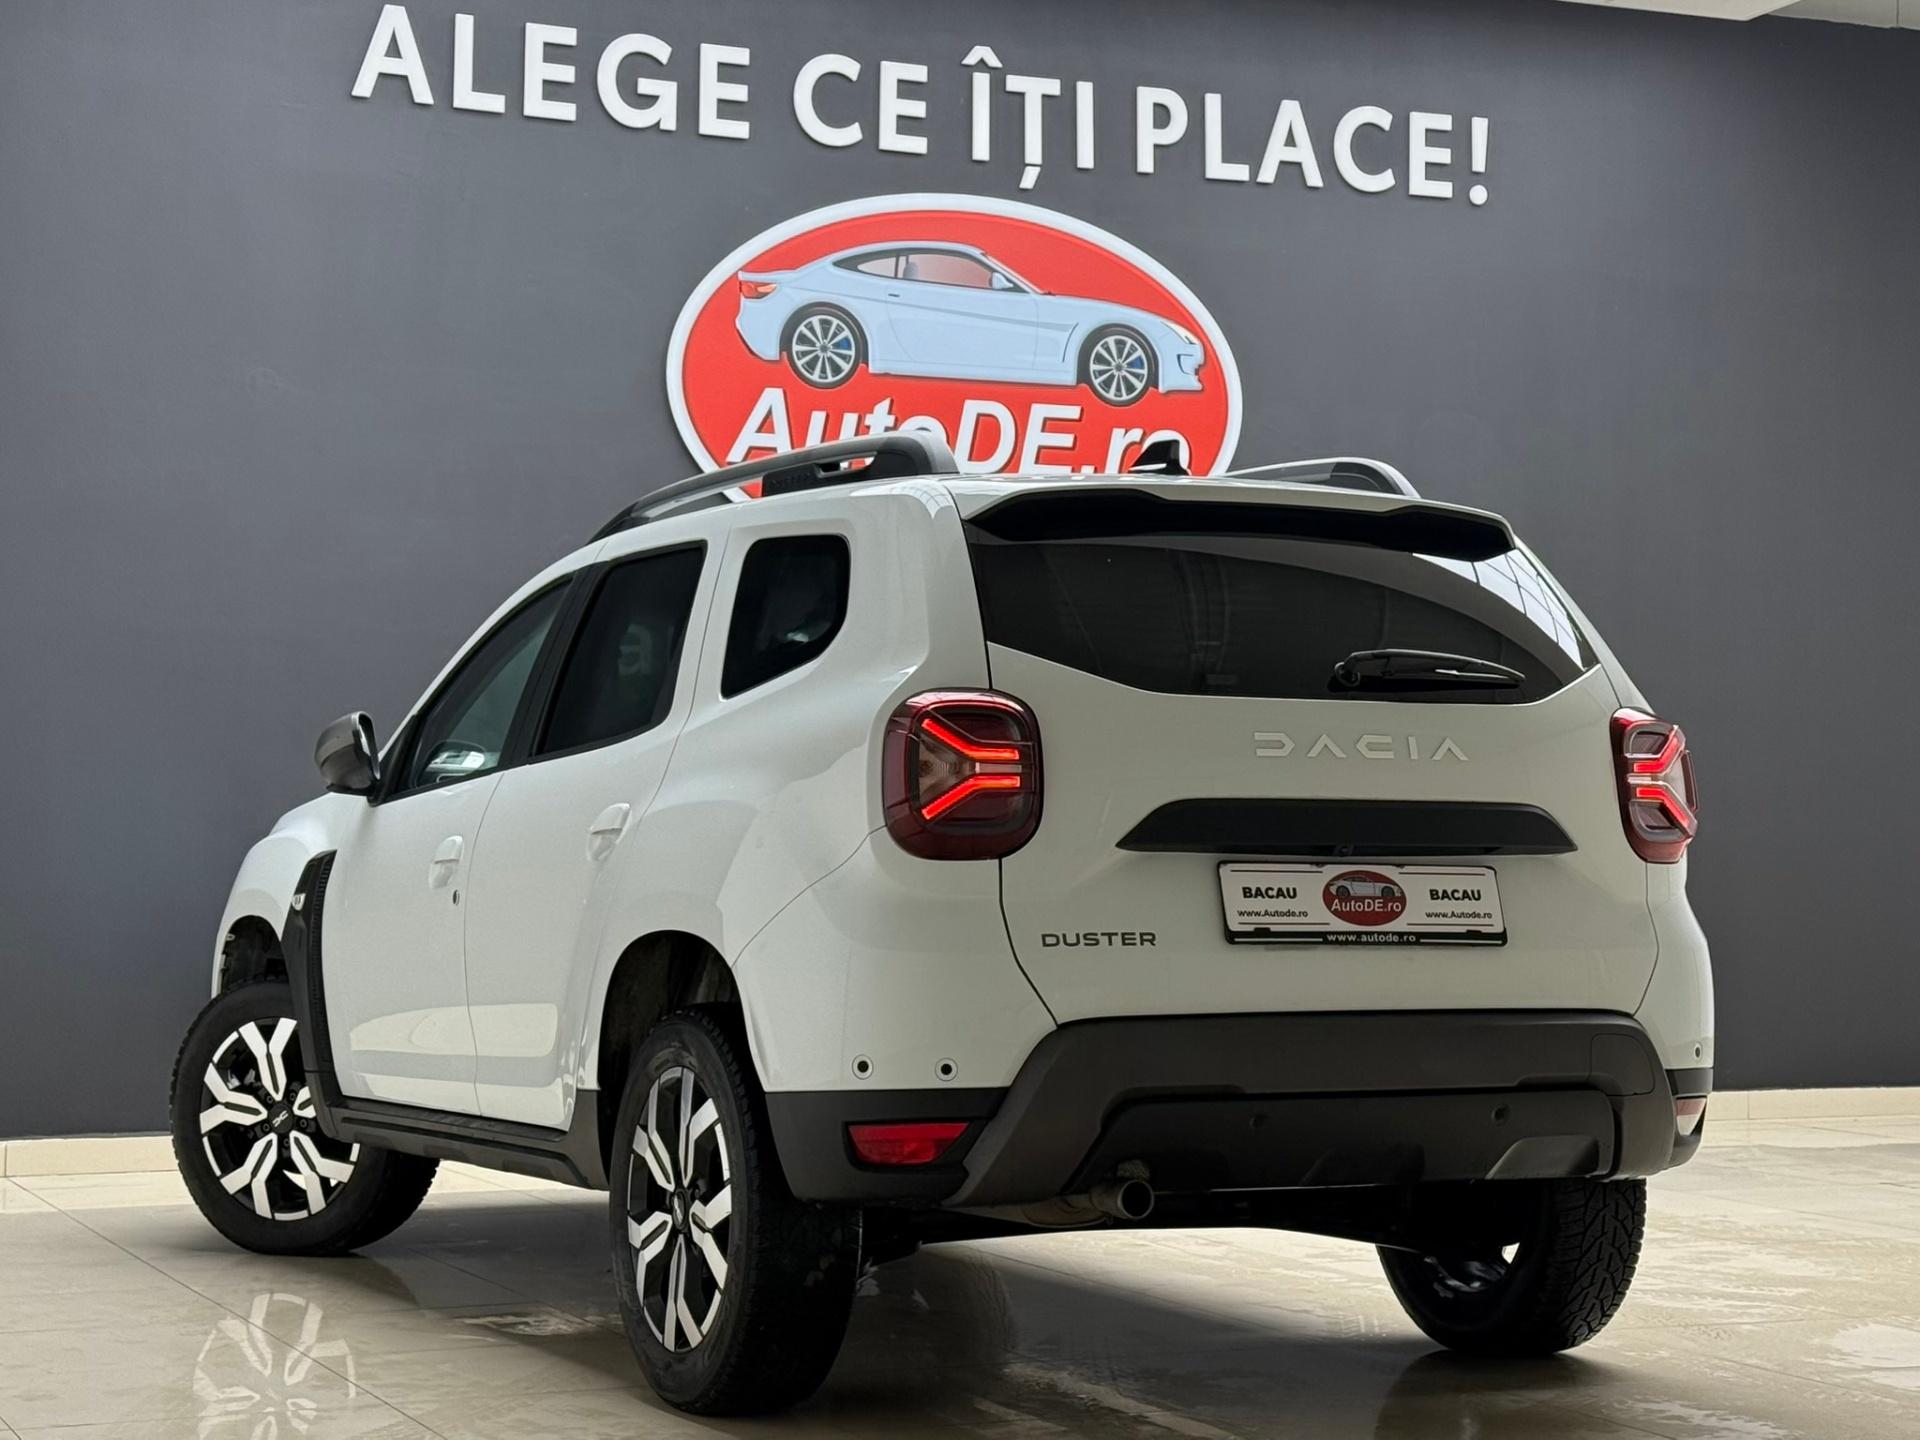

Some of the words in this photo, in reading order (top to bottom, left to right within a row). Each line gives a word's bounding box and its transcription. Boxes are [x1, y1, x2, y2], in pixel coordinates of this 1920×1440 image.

[350, 3, 751, 140] ALEGE
[793, 52, 929, 155] CE
[960, 45, 1095, 190] ÎȚI
[1135, 85, 1489, 206] PLACE!
[1254, 731, 1470, 761] DACIA
[1241, 886, 1298, 900] BACAU
[1429, 888, 1482, 902] BACAU
[1331, 898, 1402, 913] AutoDE.ro
[1236, 909, 1309, 919] www.Autode.ro
[1424, 910, 1493, 920] www.Autode.ro
[1041, 931, 1156, 948] DUSTER
[1326, 932, 1417, 943] www.autode.ro
